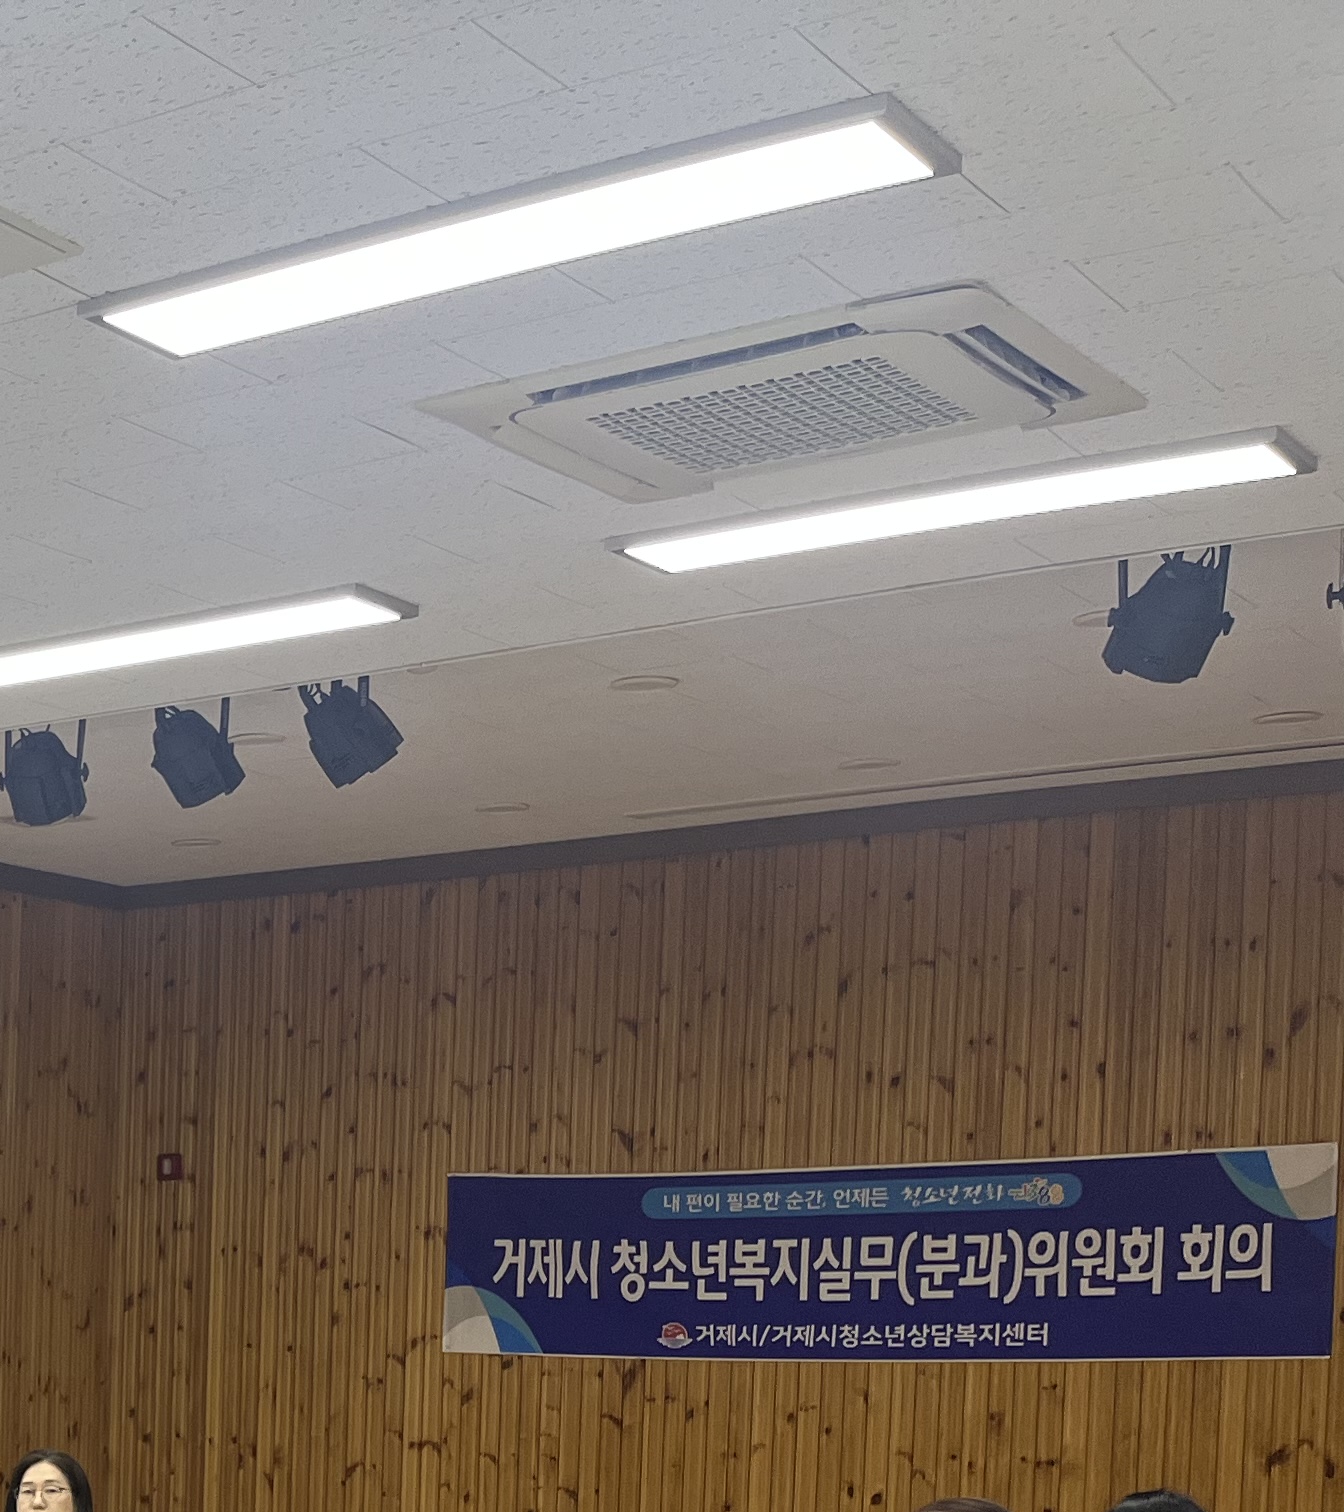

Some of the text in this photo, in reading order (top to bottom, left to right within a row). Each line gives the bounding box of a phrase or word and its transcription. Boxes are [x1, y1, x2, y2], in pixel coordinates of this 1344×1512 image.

[663, 1193, 680, 1212] 내
[686, 1193, 720, 1213] 편이
[726, 1191, 781, 1212] 필요한
[784, 1190, 826, 1211] 순간,
[832, 1187, 890, 1209] 언제든
[492, 1222, 1274, 1307] 거제시 청소년복지실무(분과)위원회 회의
[695, 1322, 1051, 1348] 거제시/거제시청소년상담복지센터
